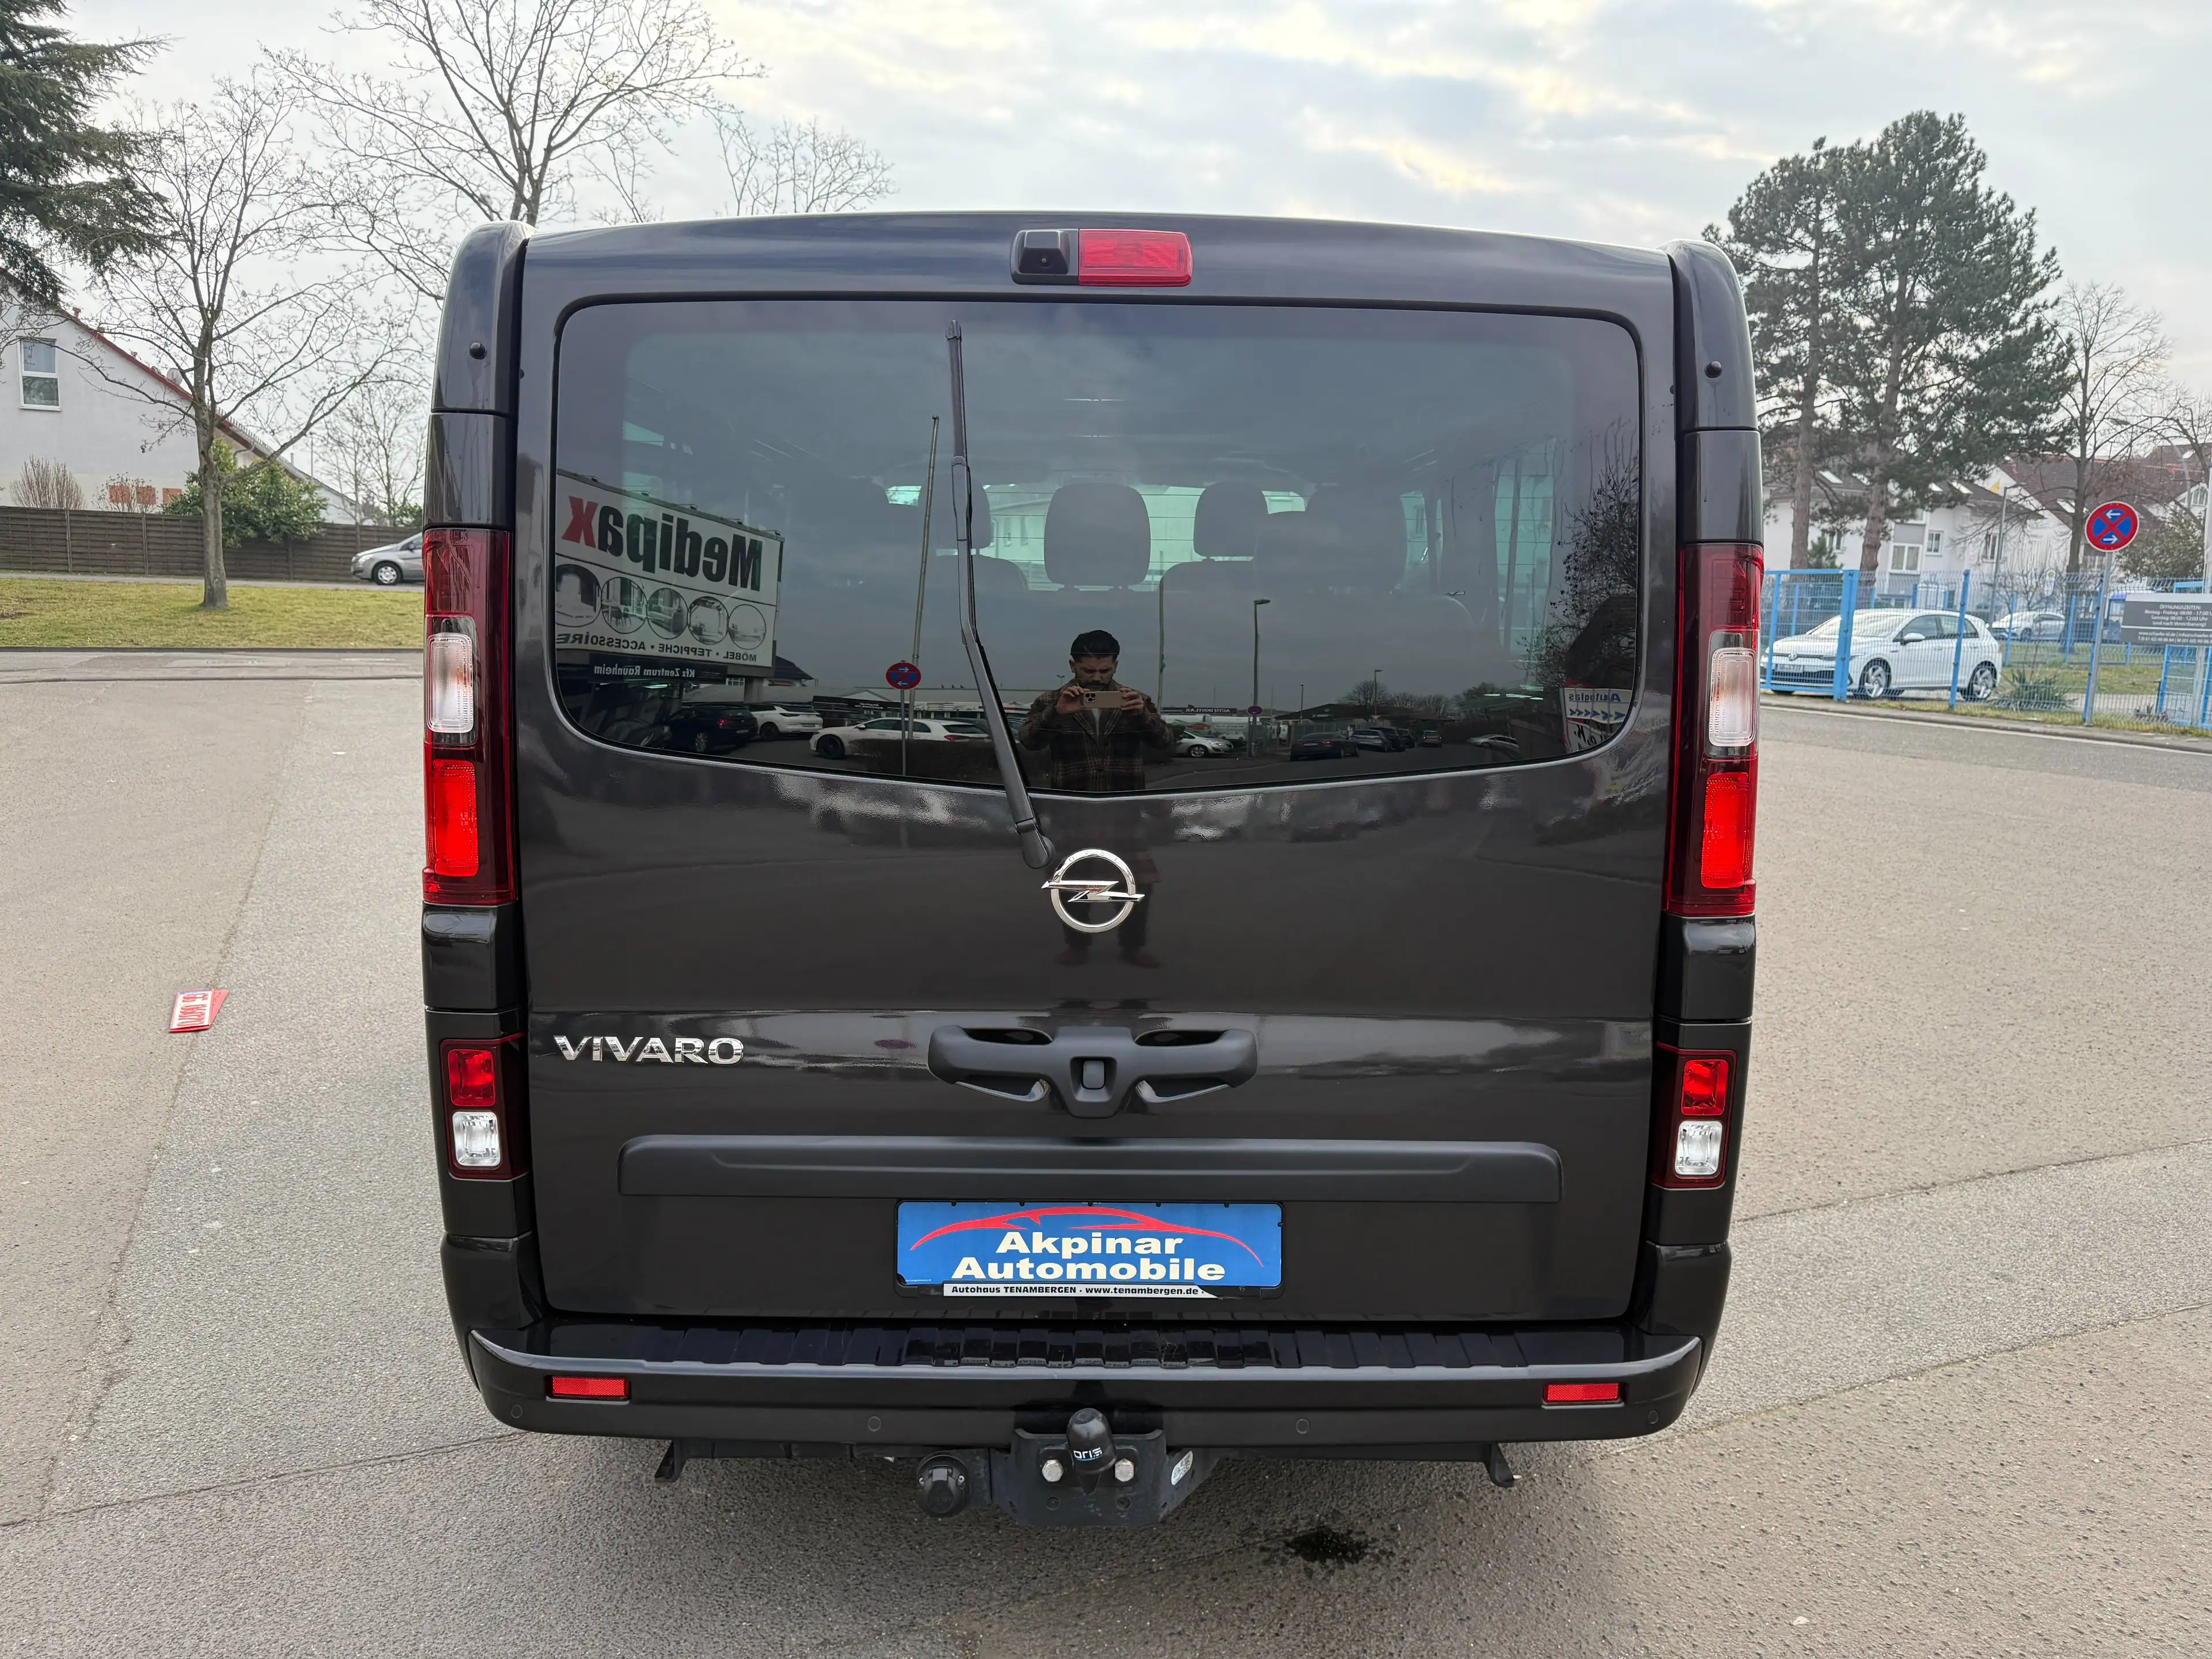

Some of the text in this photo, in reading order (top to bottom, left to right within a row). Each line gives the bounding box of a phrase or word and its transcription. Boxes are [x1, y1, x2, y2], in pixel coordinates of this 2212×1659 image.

[1068, 850, 1120, 863] OPEL
[554, 1035, 744, 1065] VIVARO
[995, 1232, 1184, 1259] Akpinar
[951, 1257, 1225, 1281] Automobile
[1085, 1286, 1199, 1295] www.tenambergen.de
